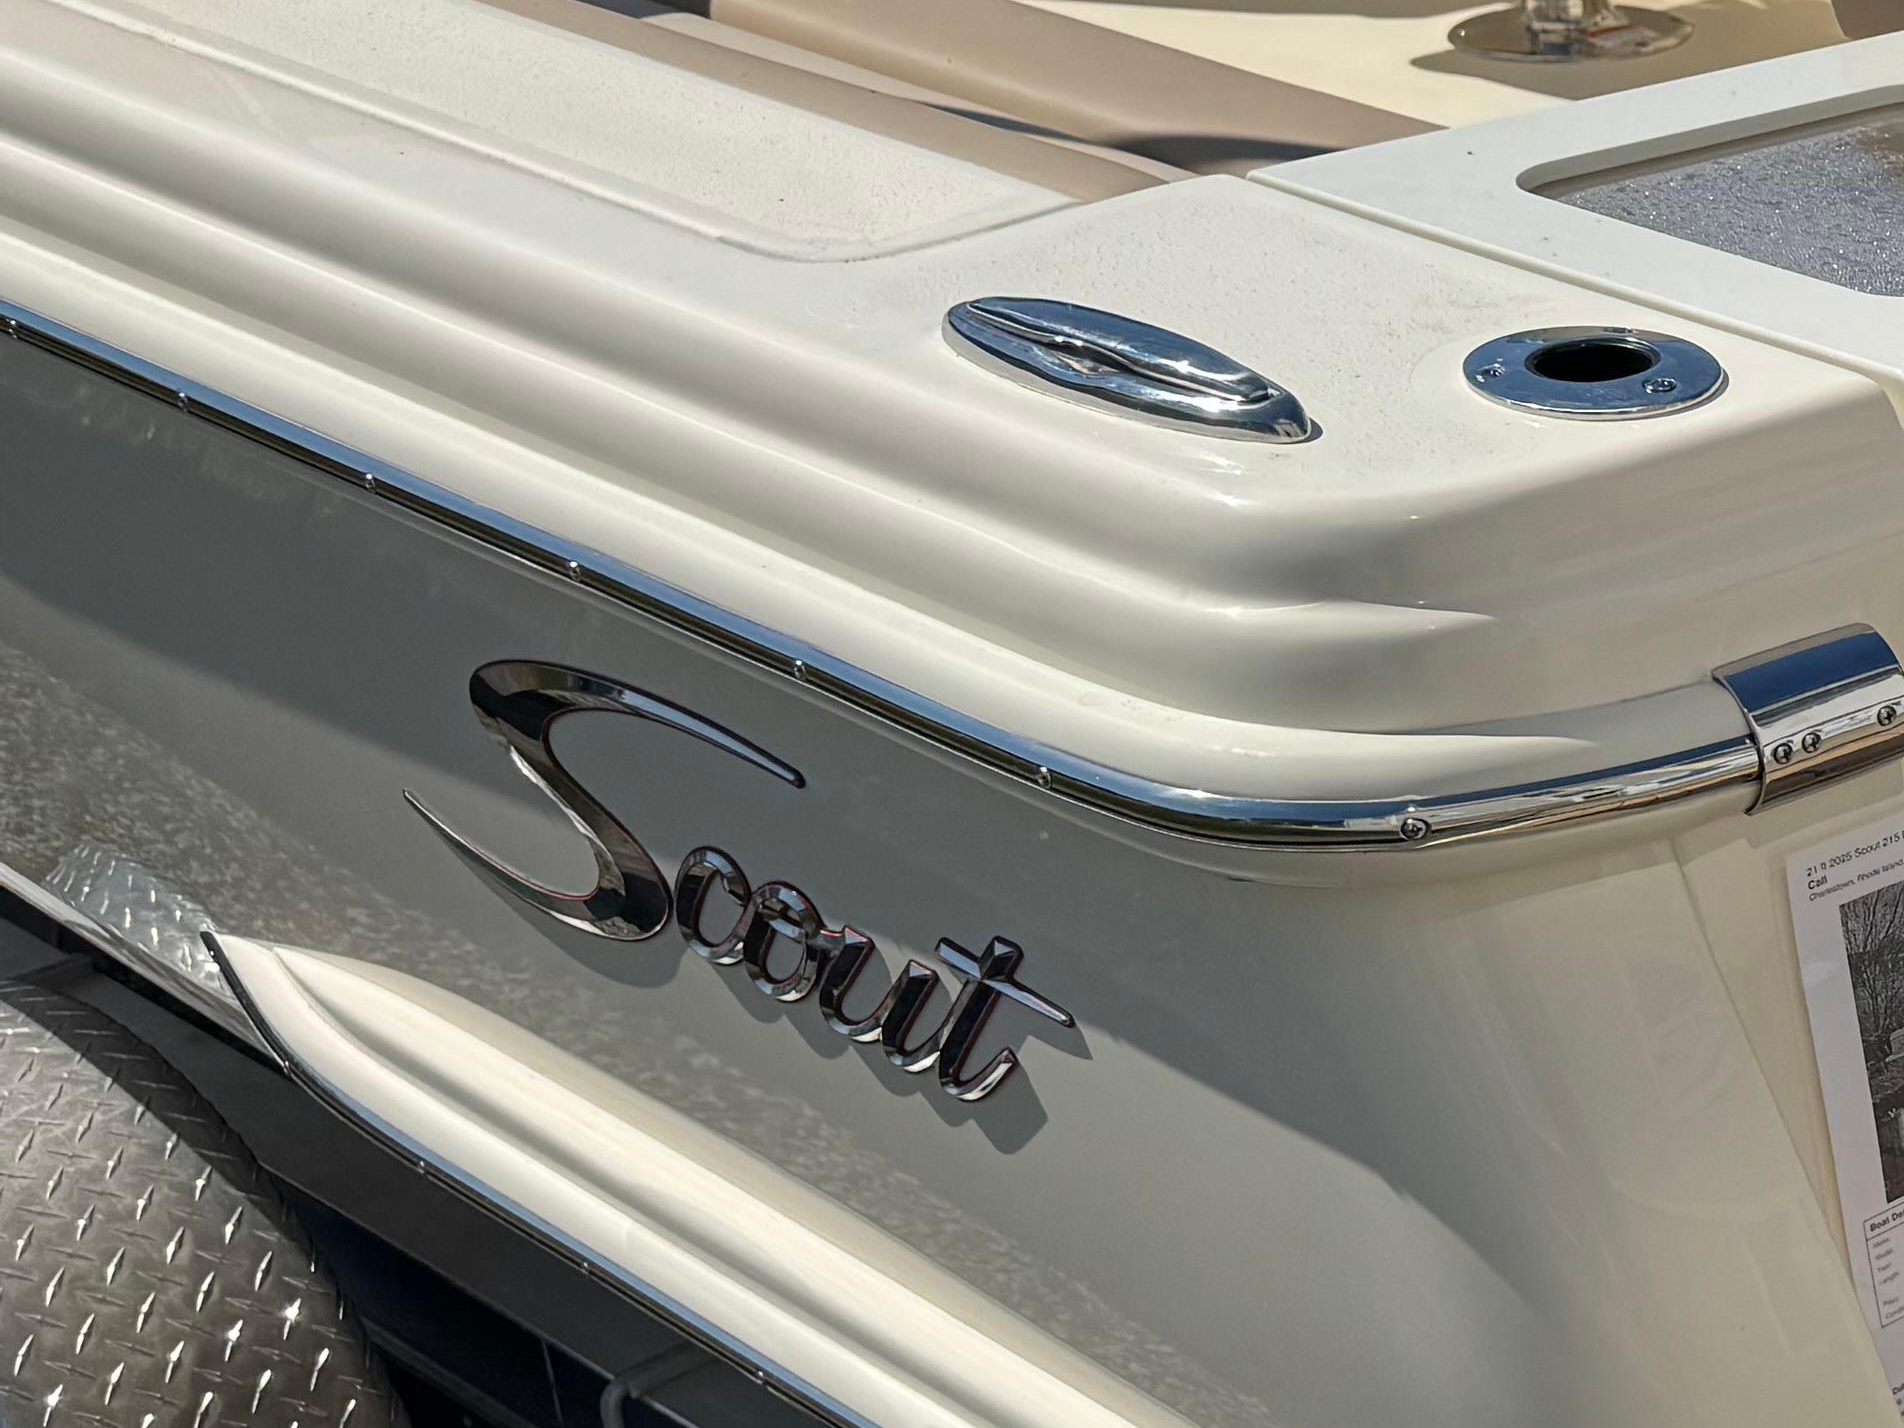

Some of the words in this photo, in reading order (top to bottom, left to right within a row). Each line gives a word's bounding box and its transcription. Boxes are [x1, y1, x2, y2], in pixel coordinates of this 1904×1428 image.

[1853, 839, 1880, 858] Scout
[1881, 831, 1900, 848] 215
[402, 658, 1076, 1103] Scout
[1807, 874, 1828, 890] Call
[1869, 1214, 1890, 1232] Boat
